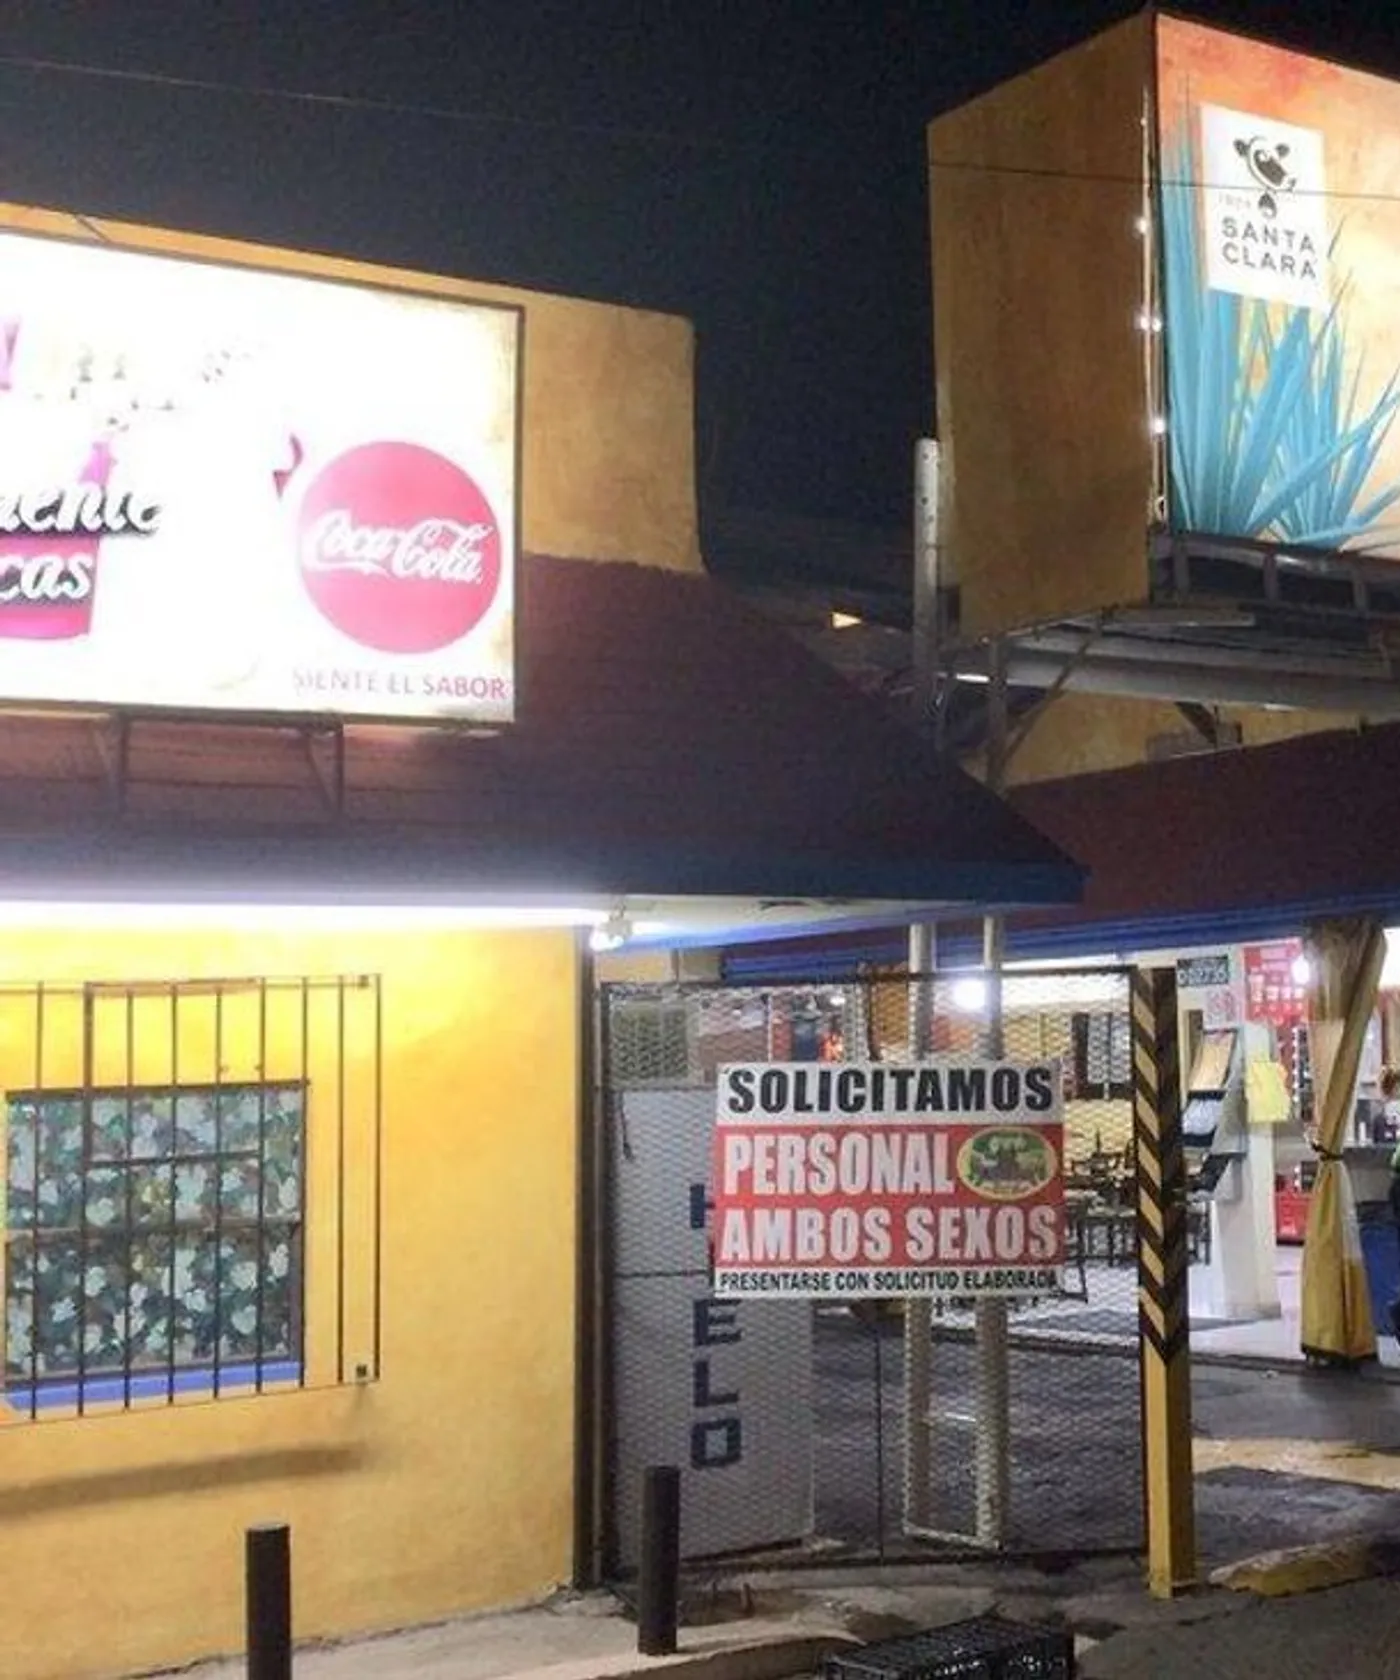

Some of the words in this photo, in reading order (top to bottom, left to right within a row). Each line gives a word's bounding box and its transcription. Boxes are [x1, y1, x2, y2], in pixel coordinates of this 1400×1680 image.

[1221, 216, 1316, 254] SANTA
[1221, 242, 1317, 279] CLARA
[386, 671, 416, 696] EL
[421, 674, 509, 701] SABOR
[727, 1067, 1053, 1113] SOLICITAMOS
[723, 1132, 955, 1196] PERSONAL
[719, 1206, 893, 1262] AMBOS
[905, 1204, 1058, 1262] SEXOS
[719, 1270, 832, 1292] PRESENTARSE
[834, 1271, 870, 1291] CON
[873, 1270, 960, 1291] SOLICITUD
